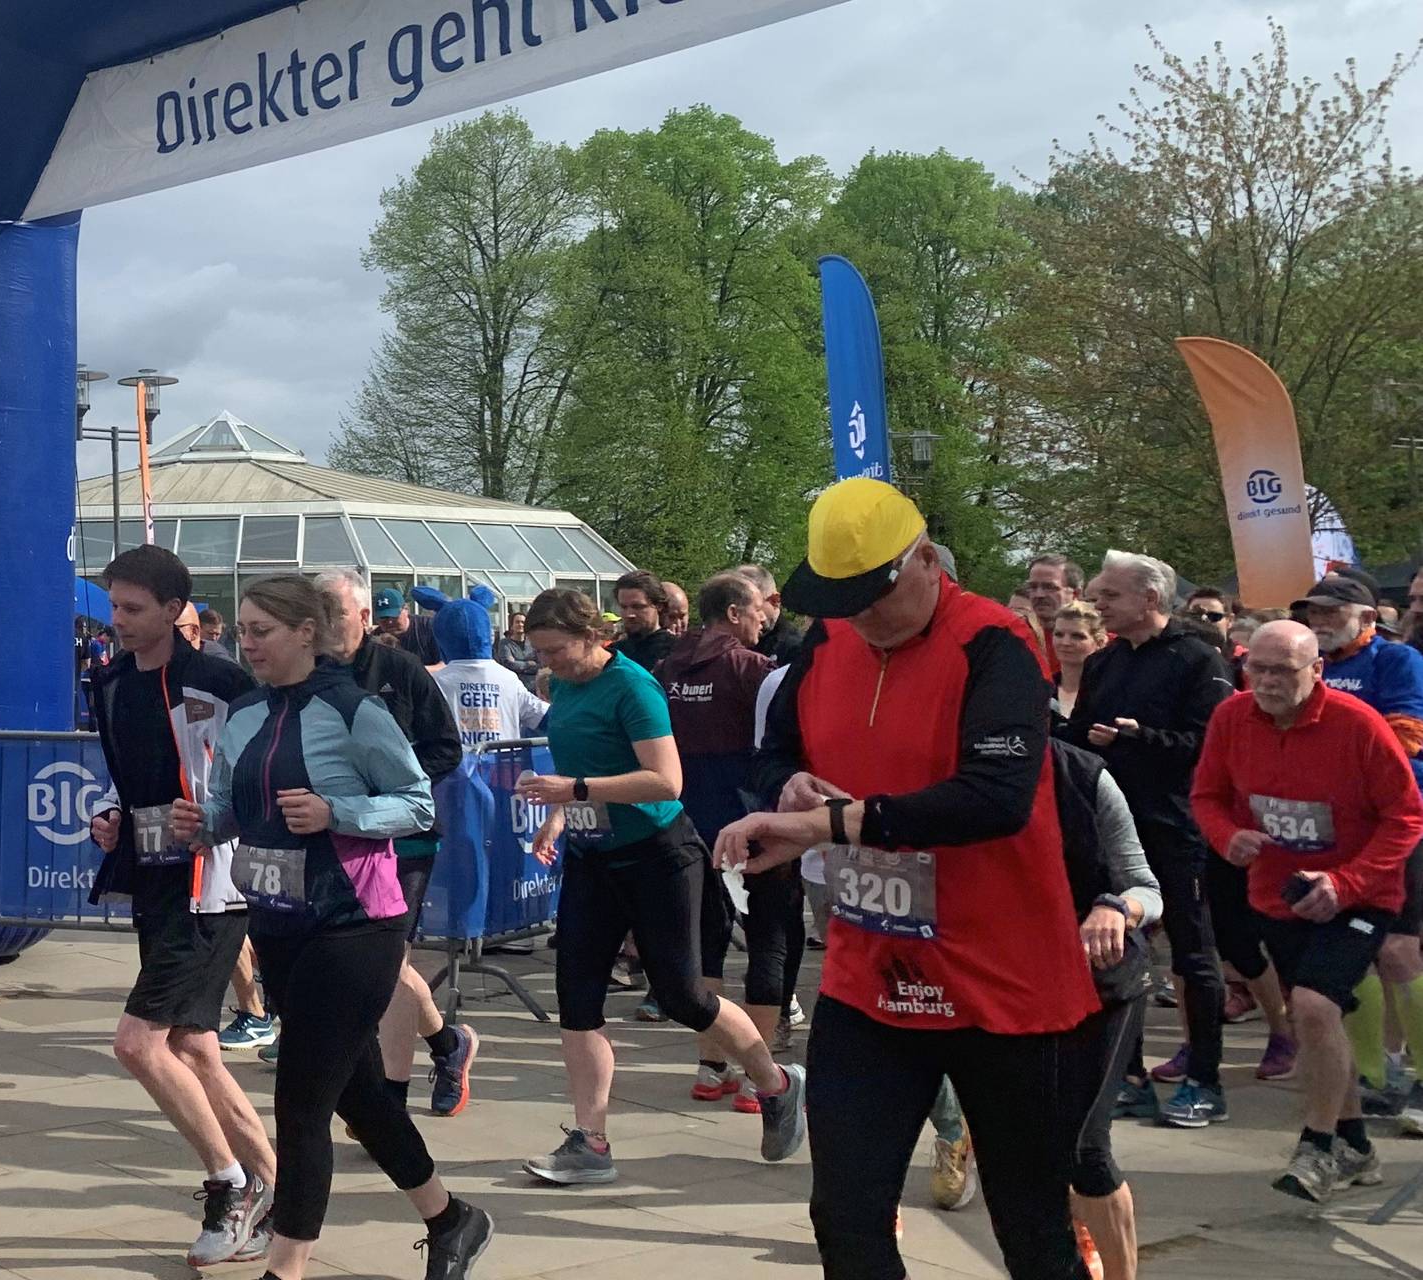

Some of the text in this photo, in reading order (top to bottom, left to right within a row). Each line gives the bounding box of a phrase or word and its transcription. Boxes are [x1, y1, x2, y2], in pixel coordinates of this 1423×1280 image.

[155, 38, 367, 154] Direkter
[1246, 477, 1282, 497] BIG
[1263, 504, 1301, 519] gesund
[460, 682, 500, 693] DIREKTER
[460, 692, 500, 708] GEHT
[1263, 813, 1318, 841] 634
[250, 862, 281, 896] 78
[512, 872, 558, 901] Direkter
[839, 867, 912, 918] 320
[897, 980, 944, 1002] Enjoy
